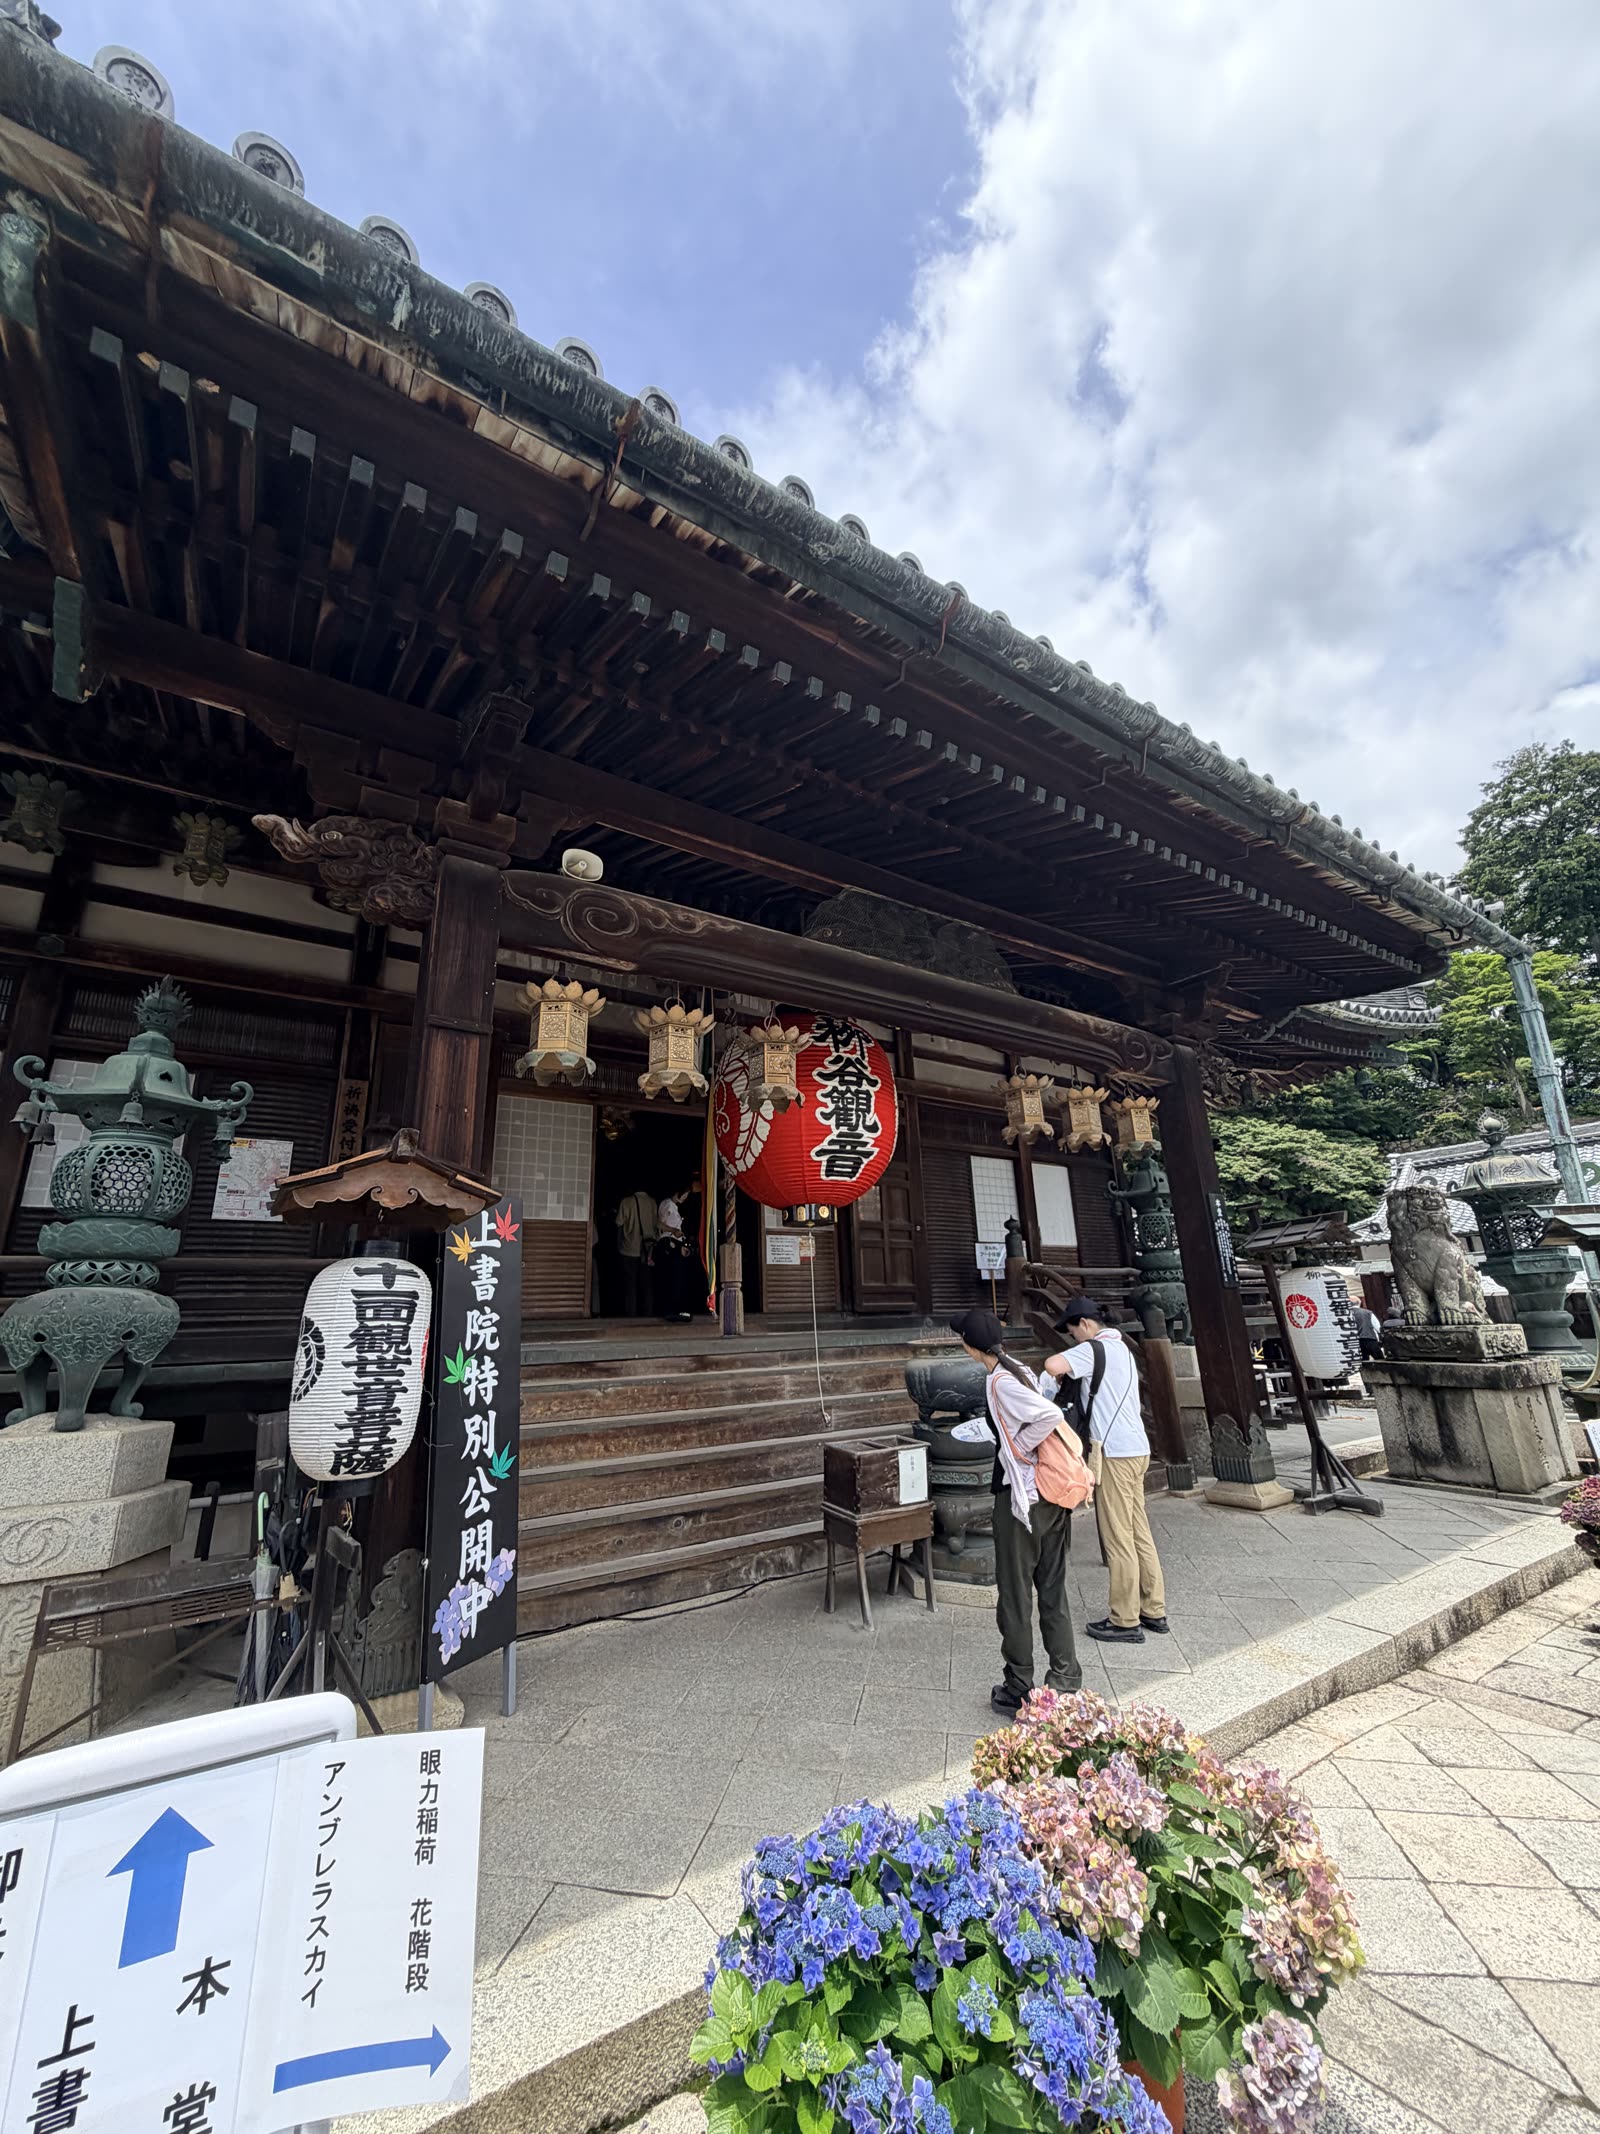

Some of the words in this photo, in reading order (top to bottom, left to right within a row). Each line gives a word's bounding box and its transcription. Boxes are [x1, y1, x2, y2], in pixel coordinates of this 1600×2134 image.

[339, 1085, 362, 1161] 祈祷受付
[329, 1262, 420, 1476] 十一面観世音菩薩
[459, 1210, 502, 1639] 上書院特別公開中
[301, 1761, 346, 2009] アンブレラスカイ
[413, 1749, 441, 1866] 眼力稲荷
[405, 1898, 432, 1993] 花階段
